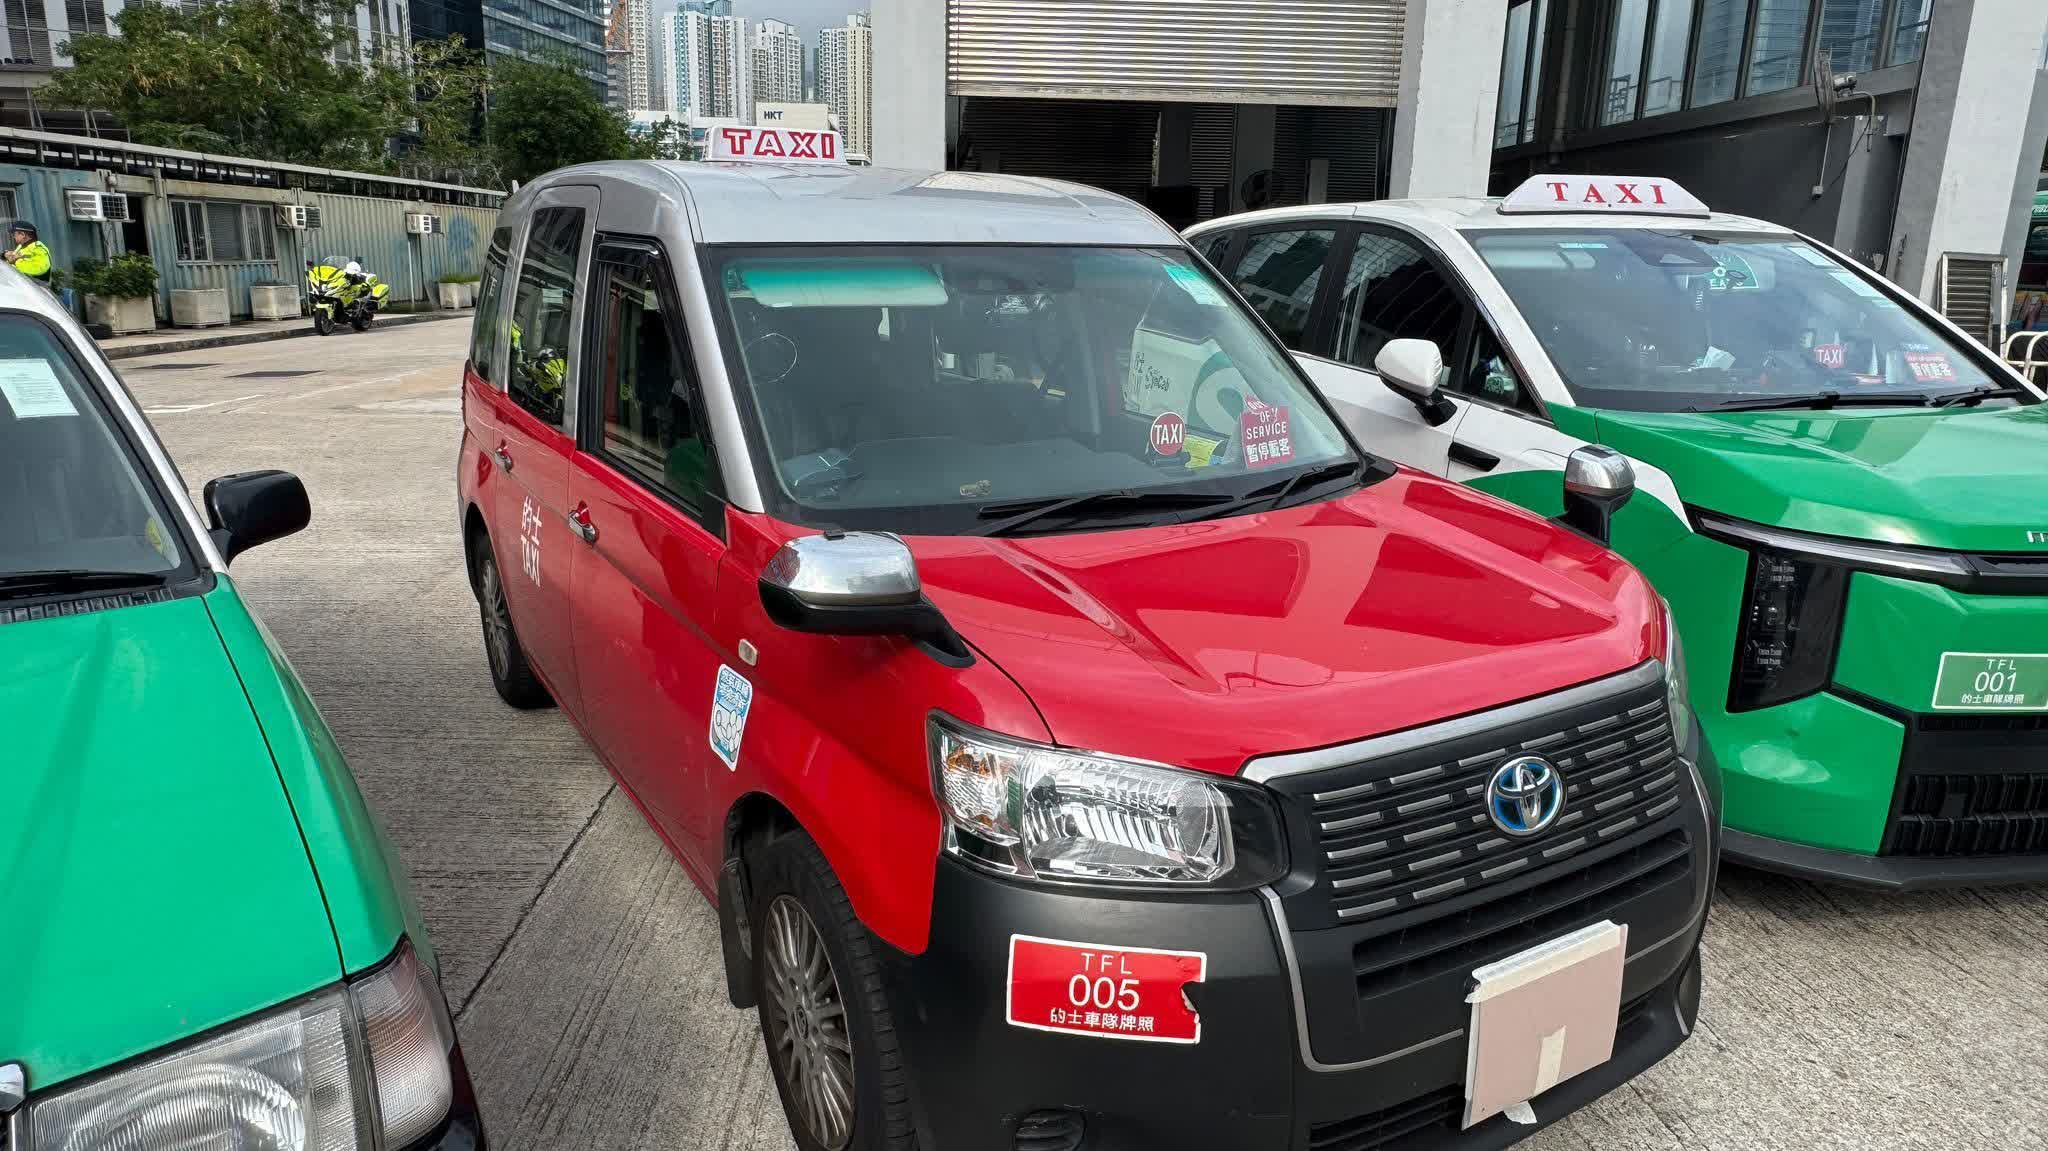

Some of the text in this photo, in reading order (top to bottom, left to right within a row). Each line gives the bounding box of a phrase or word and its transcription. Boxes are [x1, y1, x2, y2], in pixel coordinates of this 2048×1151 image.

[763, 110, 783, 120] HKT
[722, 127, 835, 160] TAXI
[1546, 182, 1667, 205] TAXI
[1818, 349, 1842, 365] TAXI
[1259, 410, 1271, 423] OF
[1154, 423, 1183, 445] TAXI
[1246, 421, 1288, 440] SERVICE
[521, 495, 543, 546] 的士
[520, 533, 541, 588] TAXI
[1987, 659, 2017, 671] TFL
[1974, 671, 2017, 692] 001
[1080, 952, 1133, 975] TFL
[1068, 974, 1140, 1011] 005
[1050, 1007, 1155, 1033] 的士車隊牌照
